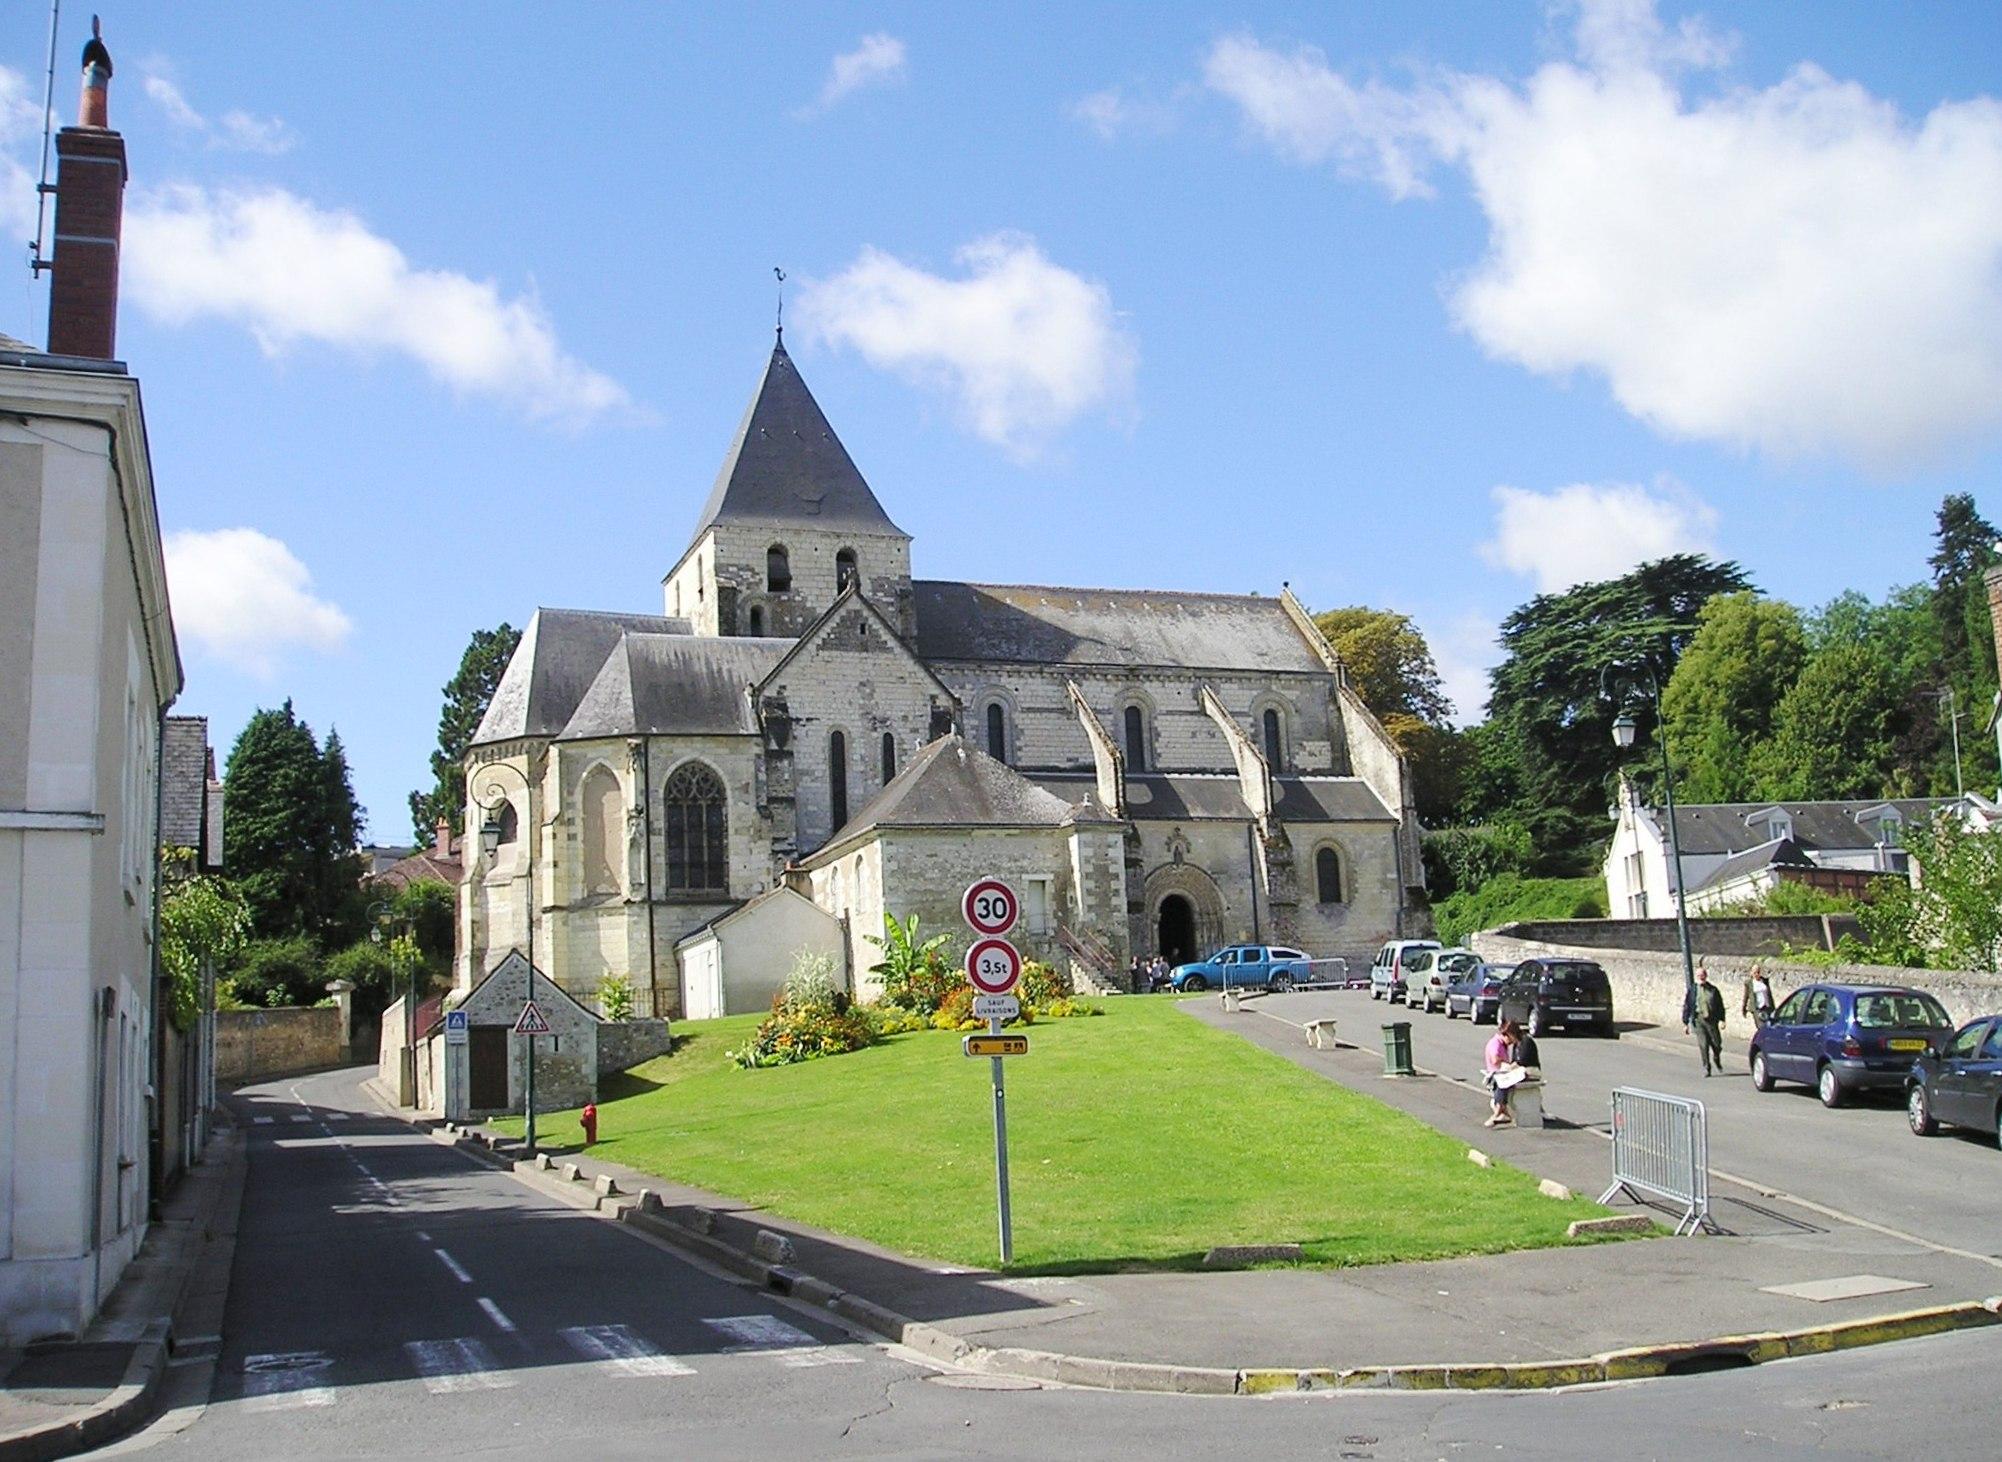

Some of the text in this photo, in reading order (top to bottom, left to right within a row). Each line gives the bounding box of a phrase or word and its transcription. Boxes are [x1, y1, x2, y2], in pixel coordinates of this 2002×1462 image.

[977, 897, 1007, 919] 30
[982, 959, 1008, 975] 3,5t
[977, 1007, 1016, 1015] LIVRAISONS
